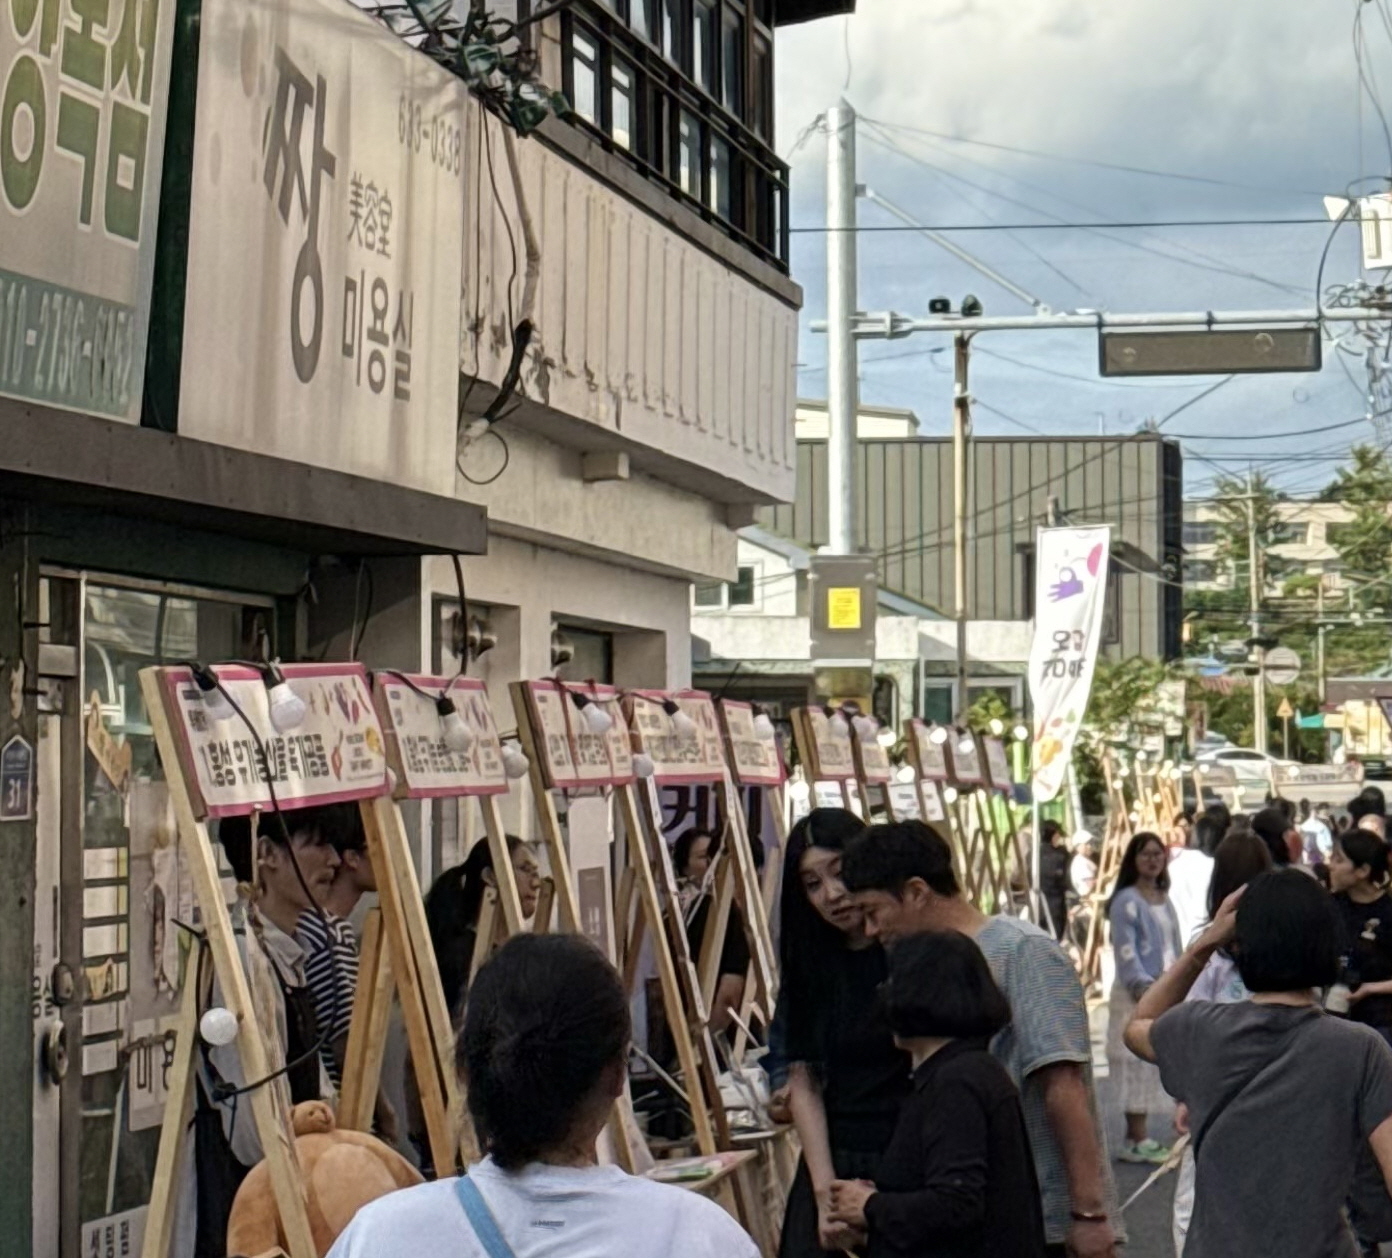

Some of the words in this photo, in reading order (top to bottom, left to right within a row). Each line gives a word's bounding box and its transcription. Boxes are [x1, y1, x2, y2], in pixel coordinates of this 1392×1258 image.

[264, 46, 336, 385] 짱
[342, 268, 414, 402] 미용실
[8, 779, 21, 808] 31
